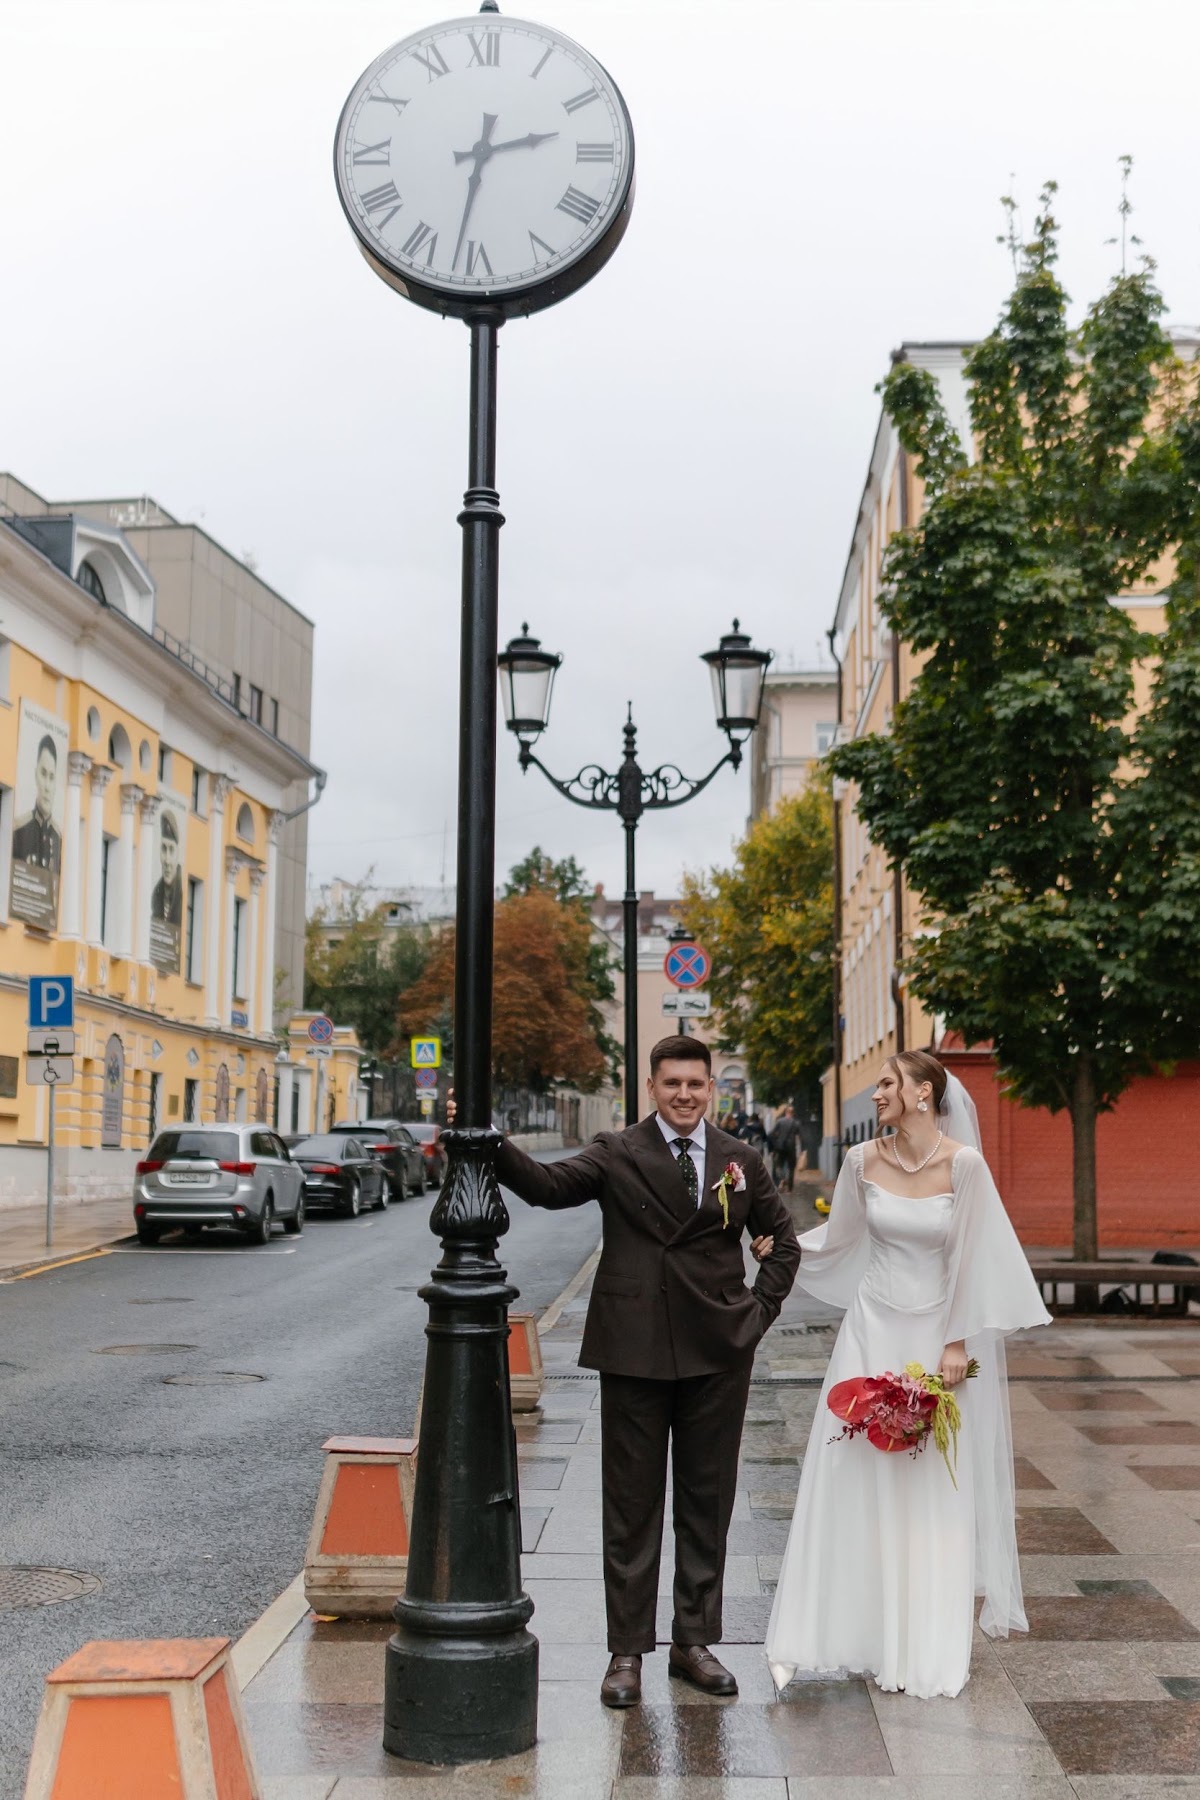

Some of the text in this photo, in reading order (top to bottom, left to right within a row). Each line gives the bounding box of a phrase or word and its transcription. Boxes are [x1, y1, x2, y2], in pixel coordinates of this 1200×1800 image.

[410, 43, 452, 83] XI
[466, 32, 501, 68] XII
[528, 46, 554, 80] I
[369, 83, 411, 116] X
[561, 85, 600, 116] II
[353, 137, 392, 167] IX
[576, 141, 614, 164] III
[359, 180, 404, 232] VIII
[554, 183, 602, 226] IIII
[398, 220, 439, 268] VII
[465, 240, 496, 277] VI
[528, 229, 560, 265] V
[41, 981, 65, 1022] P
